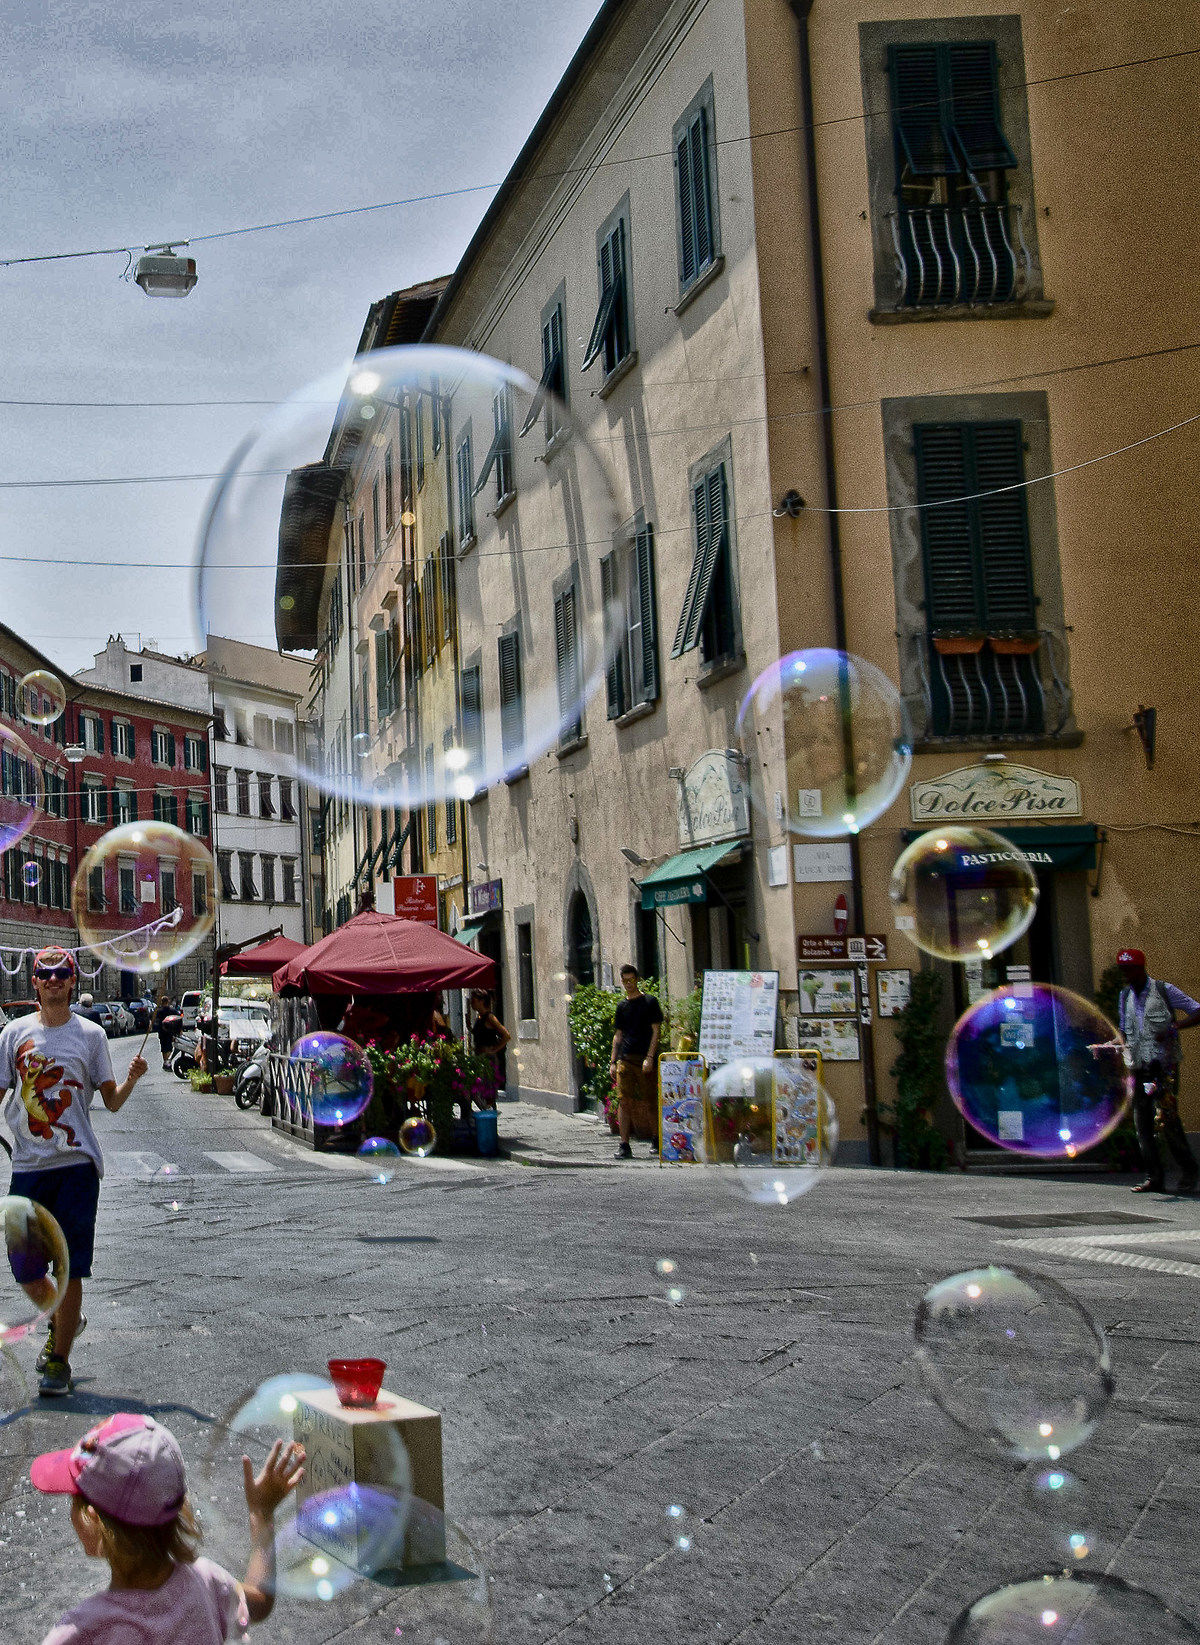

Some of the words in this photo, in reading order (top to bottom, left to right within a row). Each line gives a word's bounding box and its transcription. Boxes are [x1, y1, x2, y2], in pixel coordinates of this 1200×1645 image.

[918, 791, 996, 814] Dolce
[1001, 789, 1070, 812] Pisa
[961, 852, 1052, 866] PASTICCERIA
